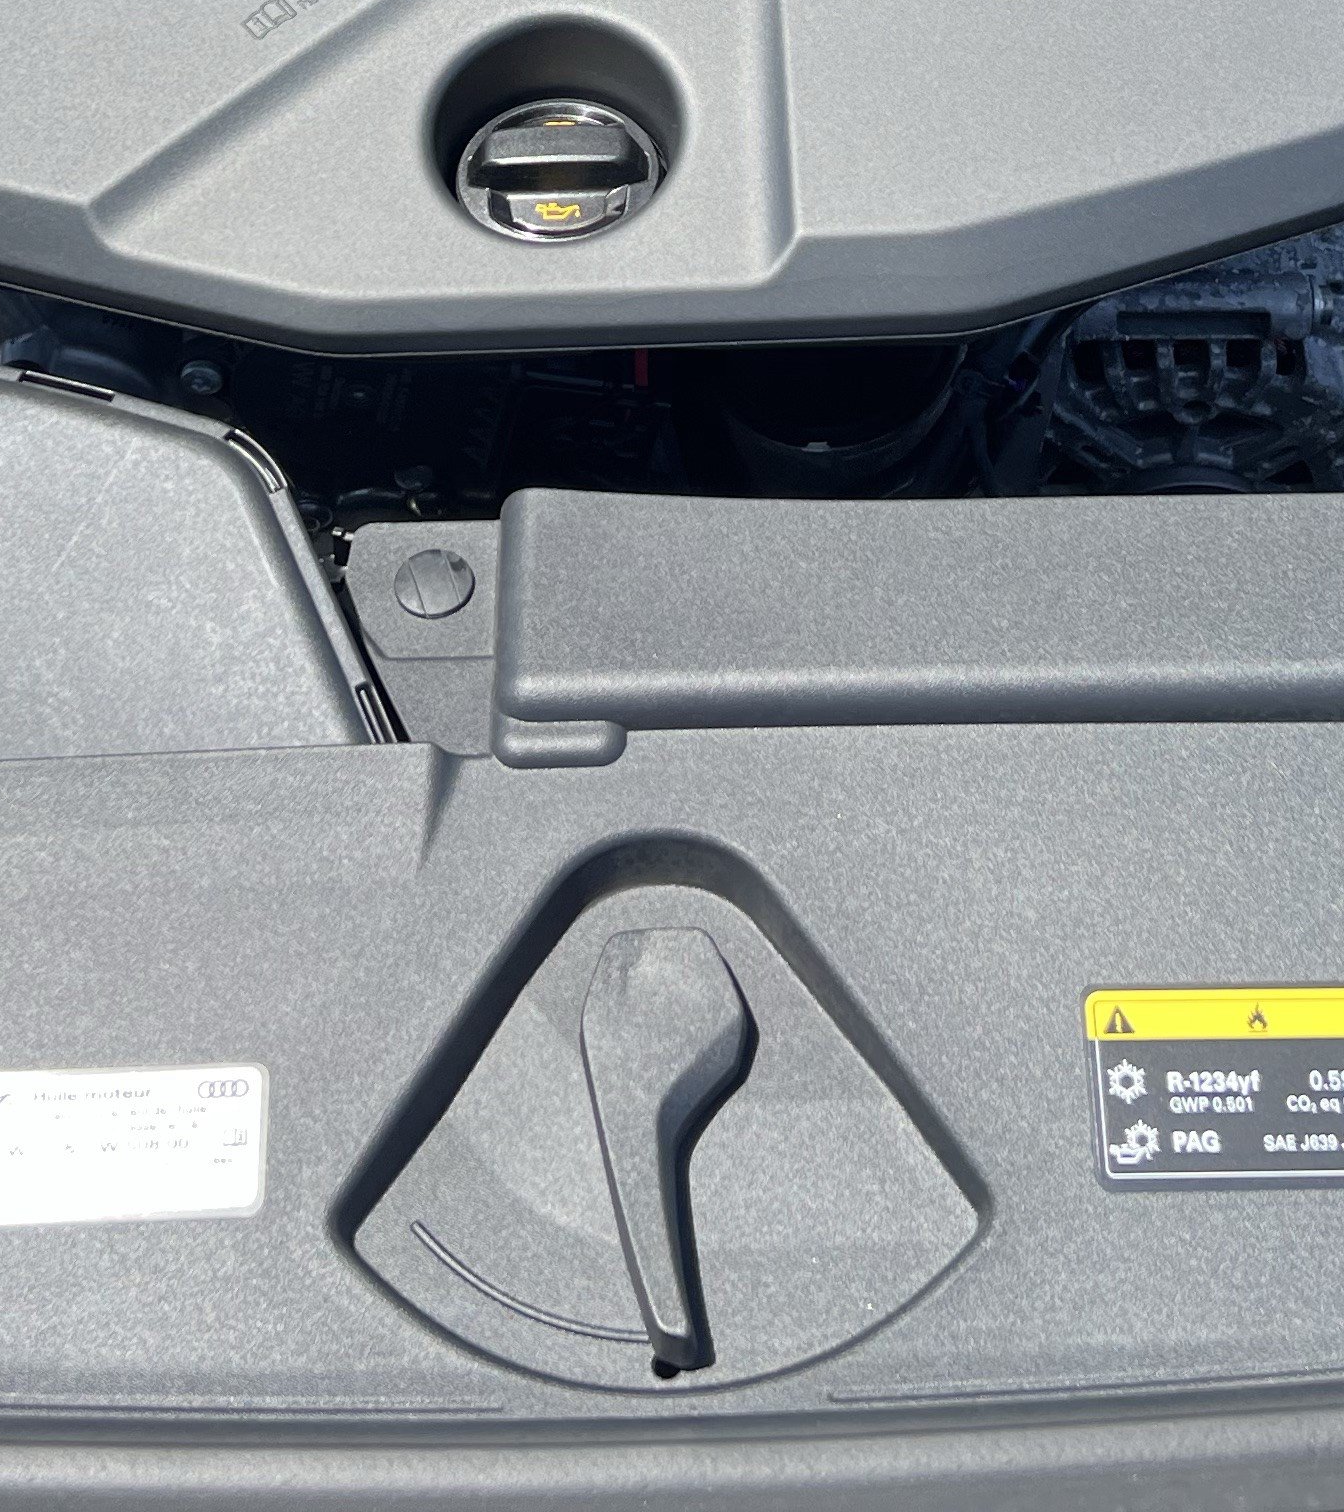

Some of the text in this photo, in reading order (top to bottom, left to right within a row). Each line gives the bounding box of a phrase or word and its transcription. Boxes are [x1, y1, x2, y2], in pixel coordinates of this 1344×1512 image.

[1166, 1069, 1261, 1096] R-1234yf
[1169, 1095, 1208, 1113] GWP
[1212, 1095, 1254, 1112] 0.501
[1320, 1098, 1342, 1114] eq
[1172, 1130, 1221, 1154] PAG
[1263, 1133, 1298, 1152] SAE
[1300, 1133, 1339, 1152] J639
